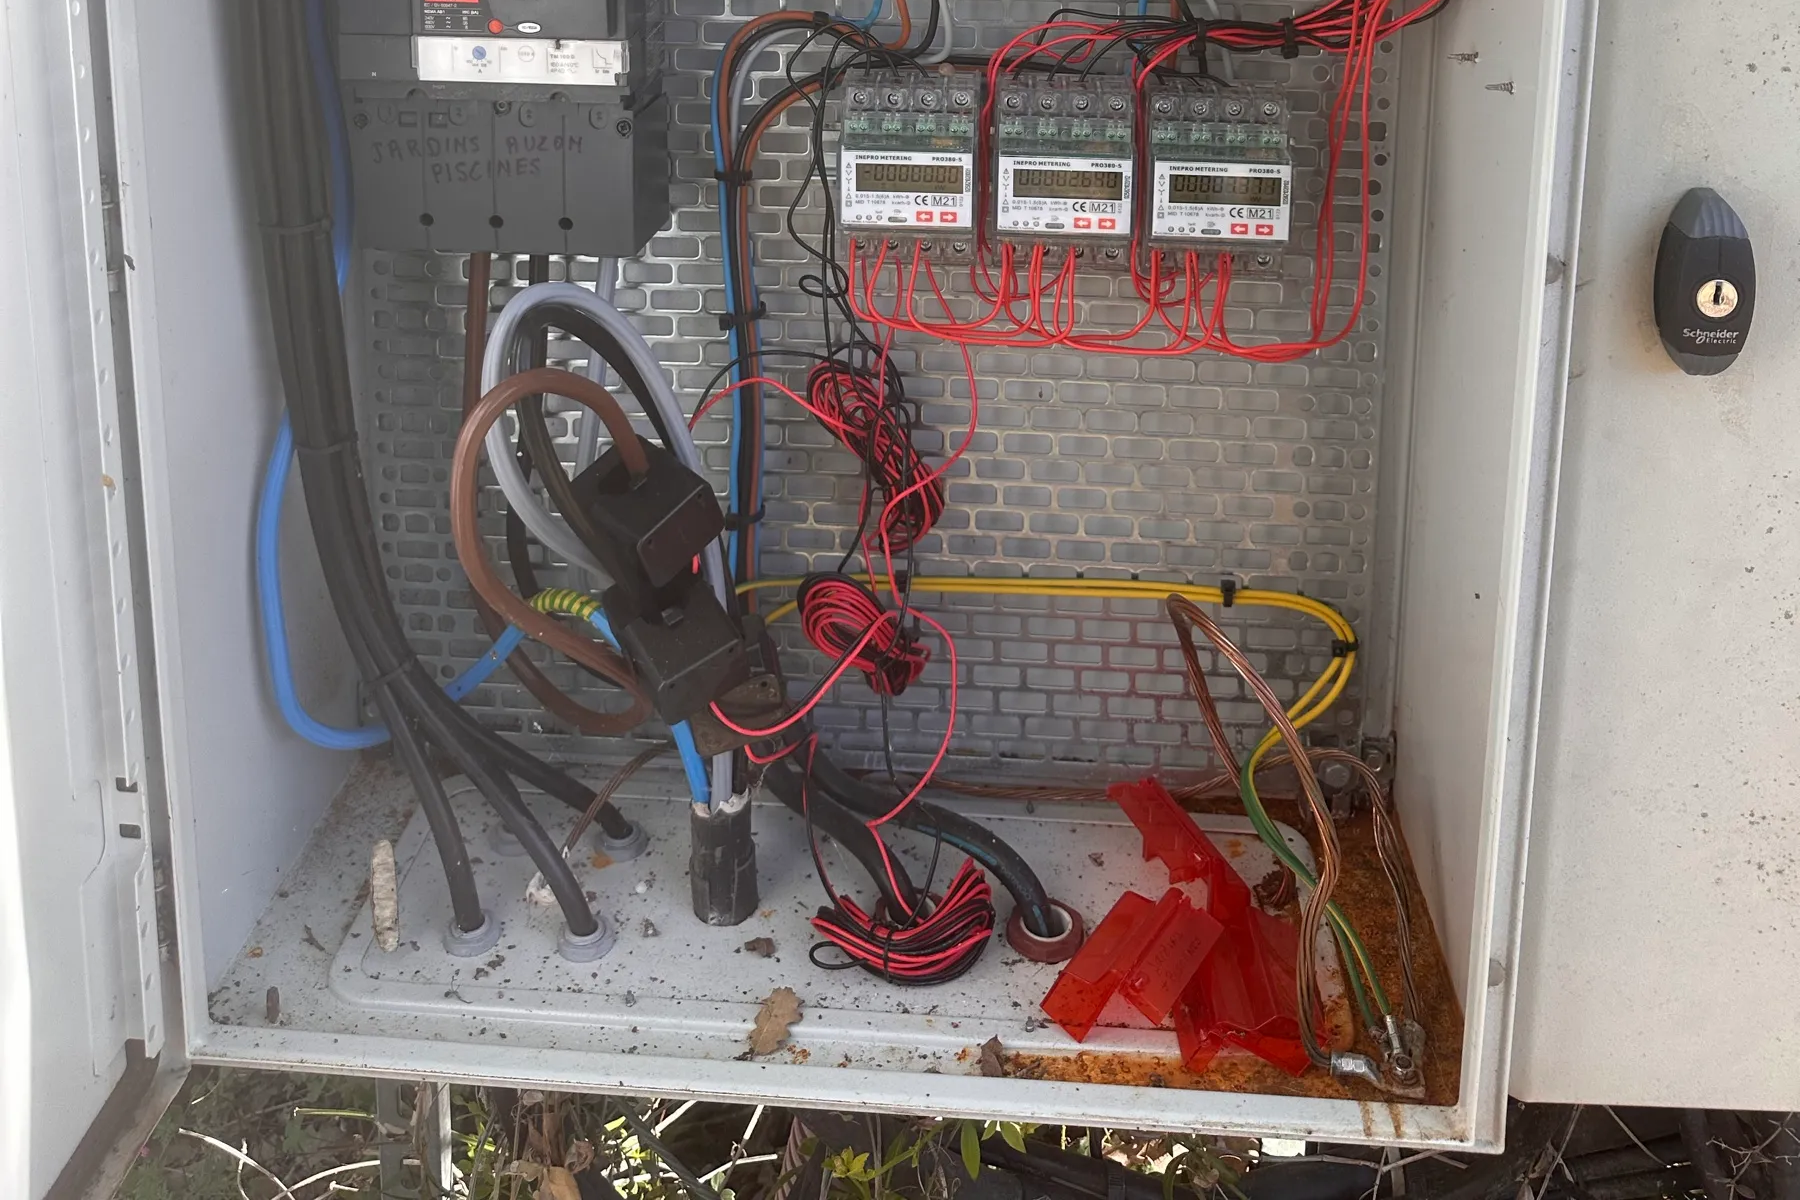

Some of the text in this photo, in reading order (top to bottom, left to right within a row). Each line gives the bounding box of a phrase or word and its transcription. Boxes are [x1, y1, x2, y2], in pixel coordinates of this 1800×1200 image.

[371, 136, 480, 163] JARDINS
[432, 158, 541, 184] PISCINES
[933, 196, 956, 205] M21
[1091, 203, 1114, 212] M21
[1249, 209, 1272, 218] M21
[1683, 328, 1739, 343] Schneider
